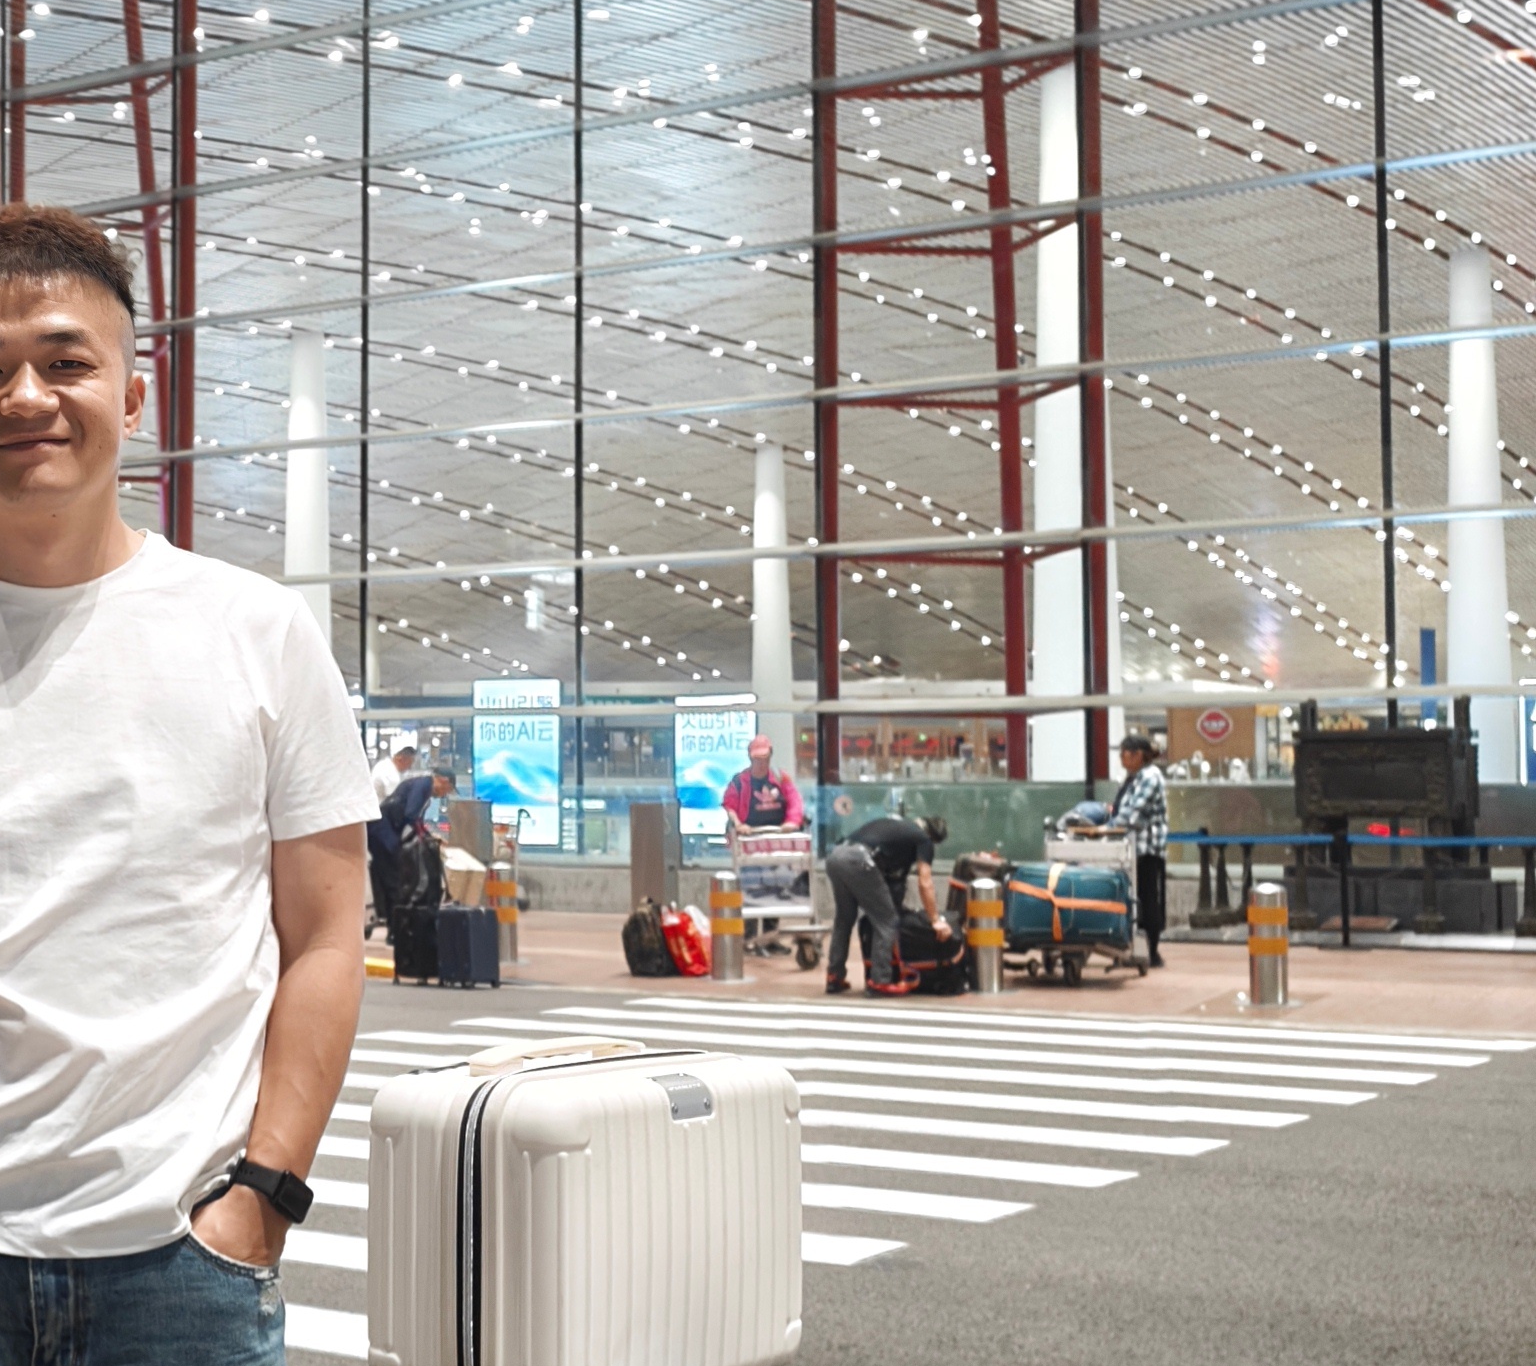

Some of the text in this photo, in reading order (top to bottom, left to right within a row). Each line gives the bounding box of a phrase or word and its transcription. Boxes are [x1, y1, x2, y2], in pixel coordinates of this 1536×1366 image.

[480, 721, 554, 741] 你的AI云
[681, 732, 749, 753] 你的AI云
